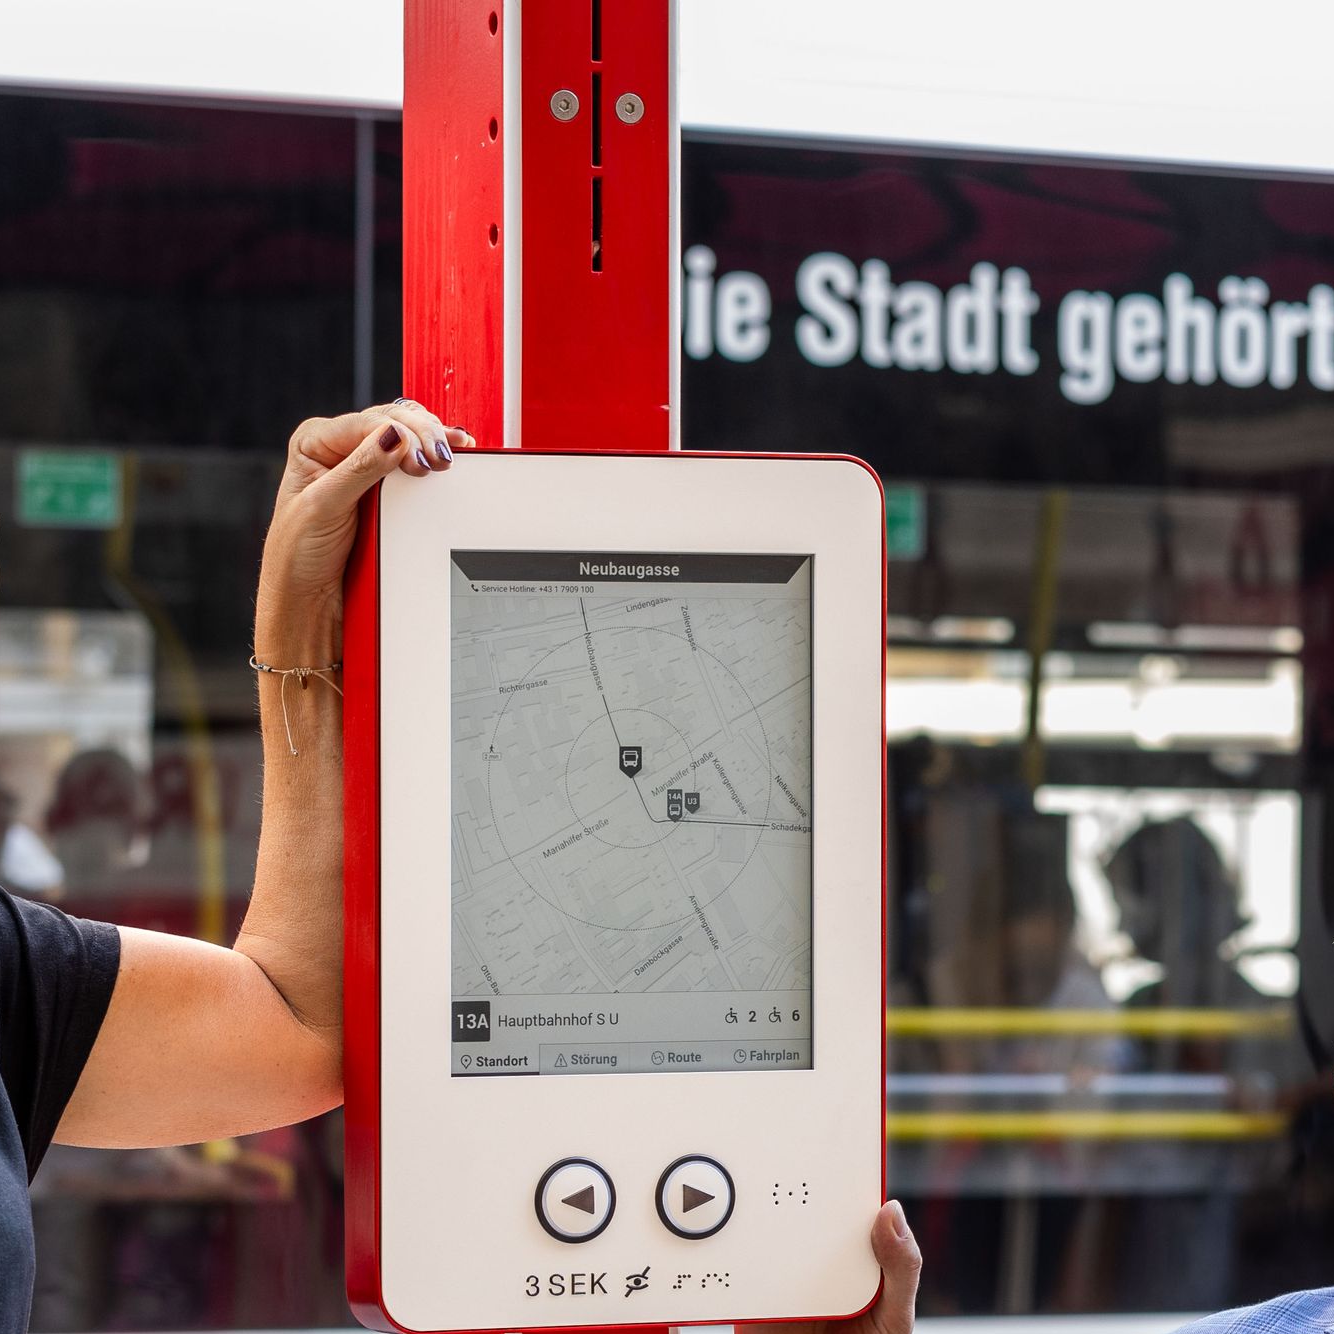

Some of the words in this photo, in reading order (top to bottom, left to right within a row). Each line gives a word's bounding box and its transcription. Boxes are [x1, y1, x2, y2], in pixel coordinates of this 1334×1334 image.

[682, 243, 772, 364] ie
[795, 251, 1040, 377] Stadt
[579, 561, 680, 579] Neubaugasse
[481, 585, 508, 593] Service
[509, 585, 537, 593] Hotline:
[539, 585, 552, 593] +43
[680, 605, 697, 652] Zollergasse
[584, 631, 604, 691] Neubaugasse
[498, 679, 548, 695] Richtergasse
[651, 768, 690, 797] Mariahilfer
[689, 751, 714, 770] Straße
[687, 797, 697, 805] U3
[774, 775, 807, 818] Nelkengasse
[542, 833, 583, 859] Mariahilfer
[584, 817, 609, 837] Straße
[688, 895, 719, 951] Amerlingstraße
[456, 1013, 489, 1030] 13A
[498, 1013, 593, 1030] Hauptbahnhof
[597, 1013, 605, 1026] S
[609, 1013, 619, 1025] U
[748, 1010, 757, 1023] 2
[792, 1009, 800, 1022] 6
[476, 1055, 528, 1067] Standort
[570, 1053, 618, 1067] Störung
[668, 1052, 702, 1063] Route
[750, 1049, 800, 1063] Fahrplan
[525, 1275, 540, 1297] 3
[548, 1272, 608, 1297] SEK
